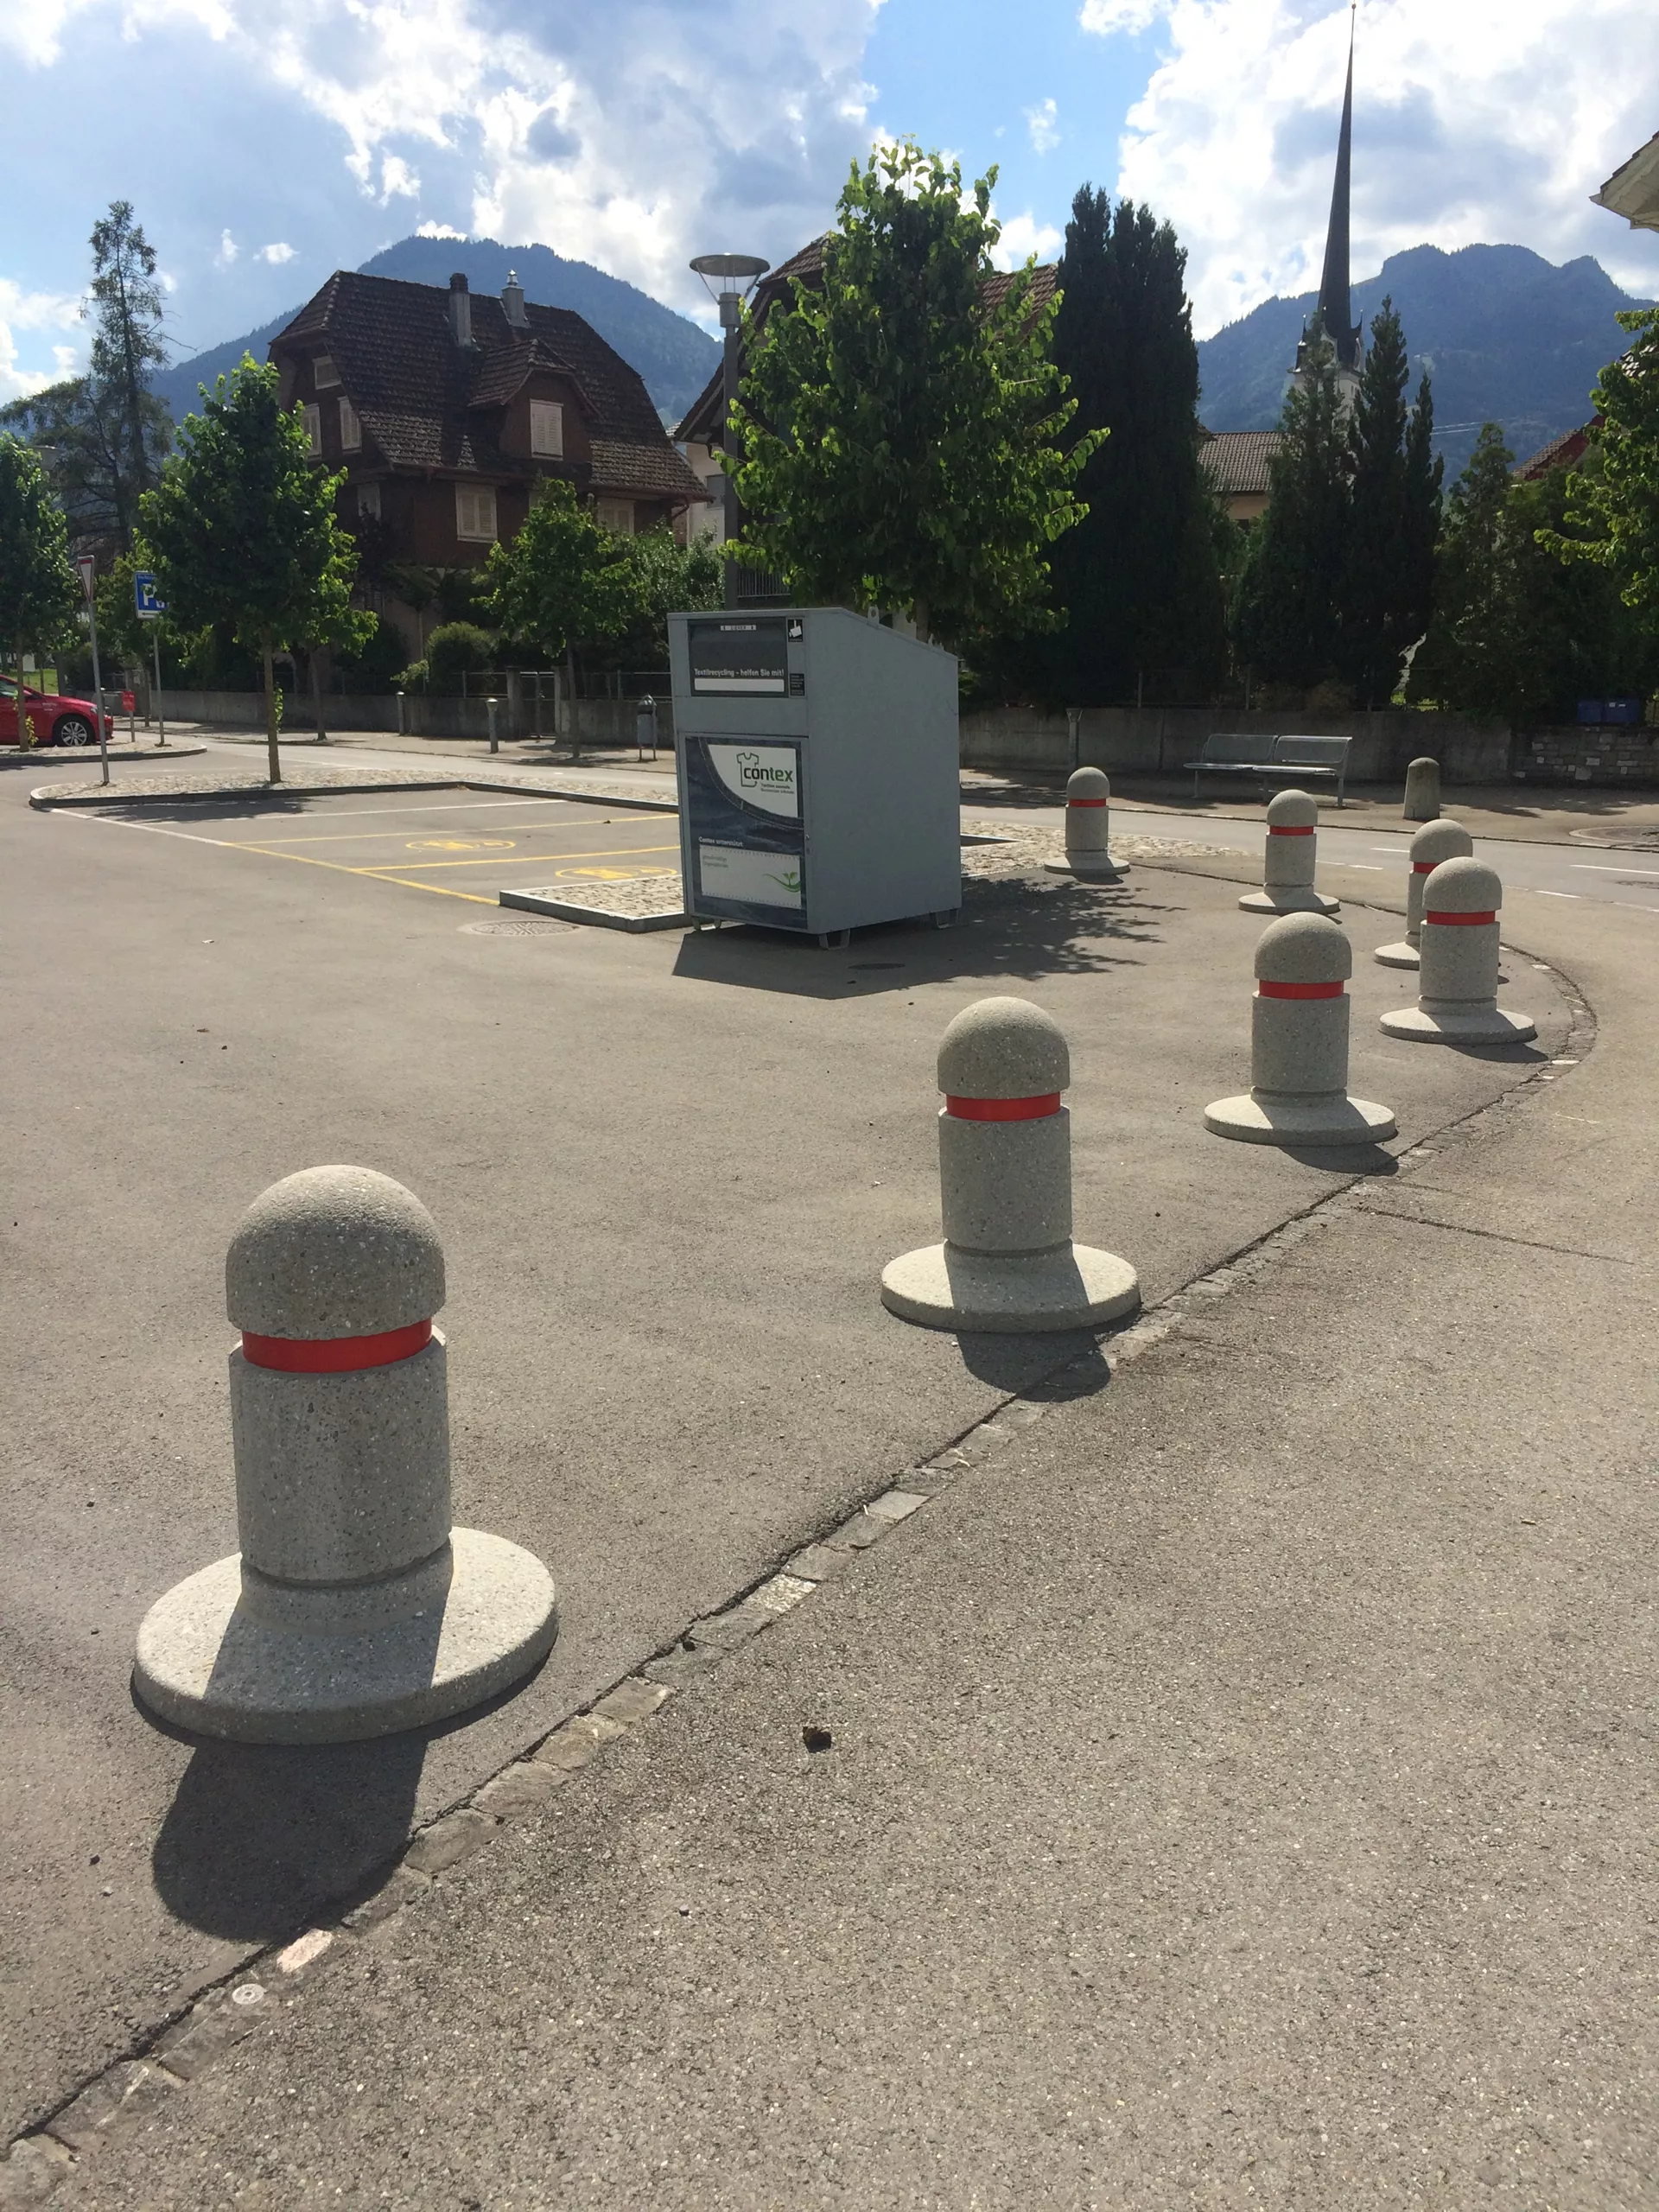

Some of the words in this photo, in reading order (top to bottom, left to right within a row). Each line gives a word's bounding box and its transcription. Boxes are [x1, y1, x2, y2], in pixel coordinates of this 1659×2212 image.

[142, 583, 157, 607] P
[694, 668, 734, 677] Textilrecycling
[741, 668, 760, 677] helfen
[760, 668, 771, 677] Sie
[772, 668, 785, 677] mit!
[743, 766, 794, 783] contex
